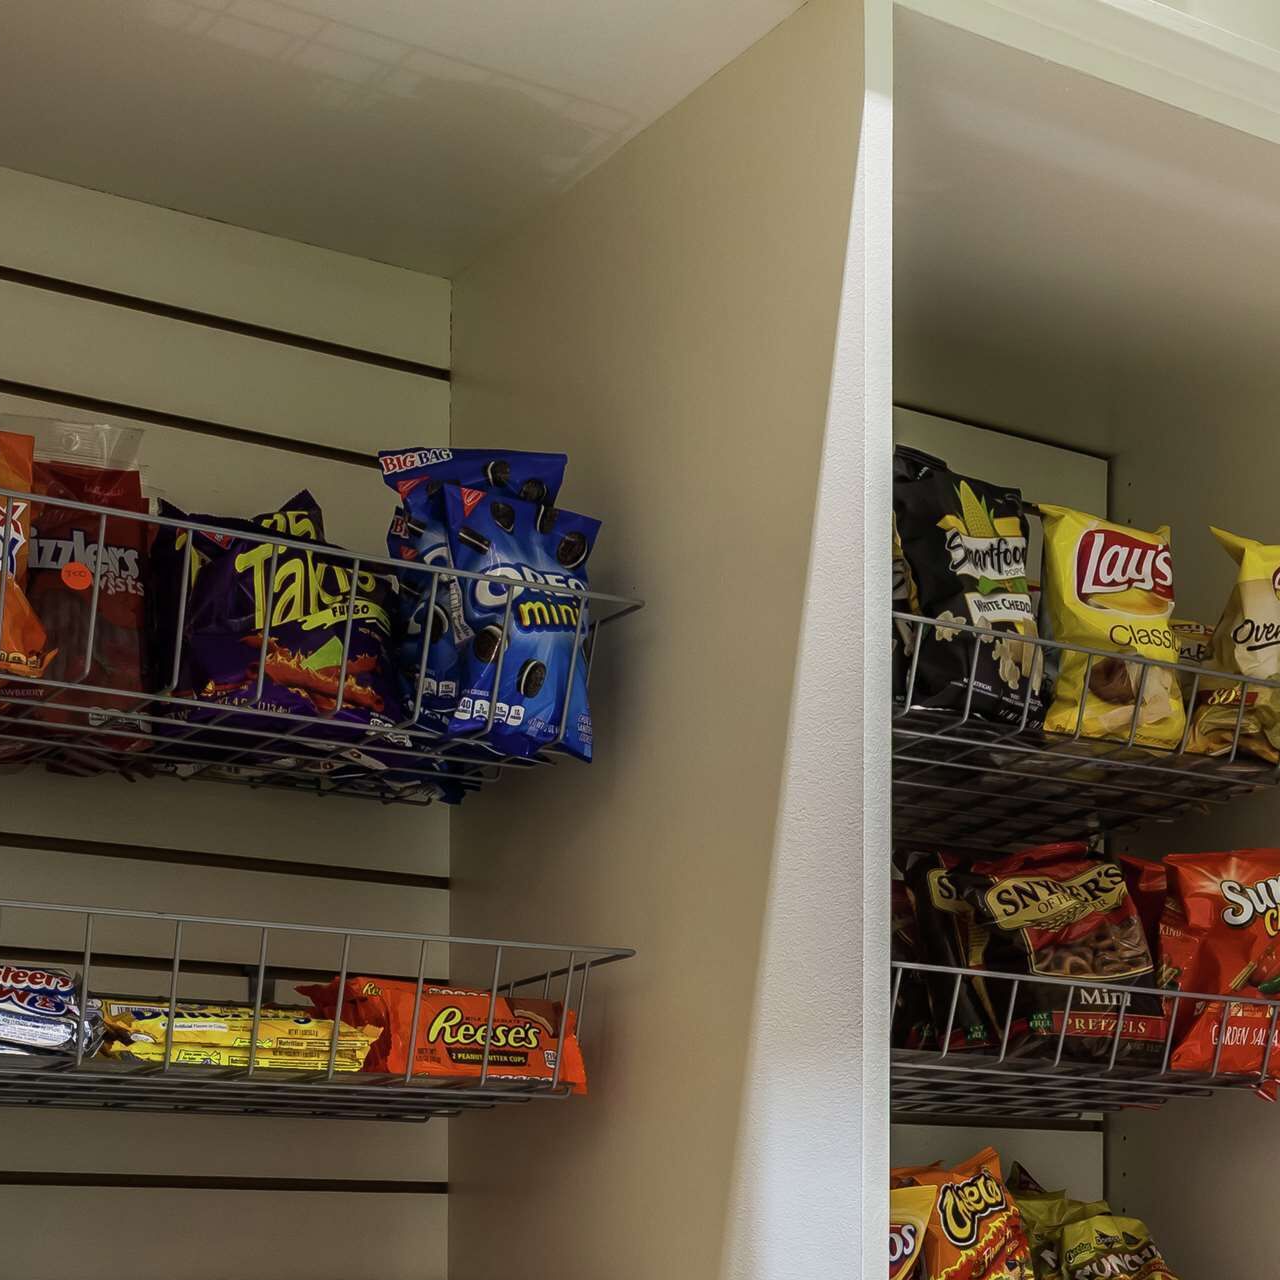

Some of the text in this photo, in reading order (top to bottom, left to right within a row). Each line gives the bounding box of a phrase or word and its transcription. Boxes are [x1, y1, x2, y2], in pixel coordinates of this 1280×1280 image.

[381, 449, 452, 473] BIG BAG
[30, 528, 139, 578] izzlers
[1082, 532, 1174, 594] Lay's
[475, 566, 587, 608] OREO
[428, 1007, 541, 1048] Reese's
[1066, 1017, 1147, 1035] PRETZELS
[458, 1052, 483, 1061] PEANUT
[509, 1054, 526, 1063] CUPS
